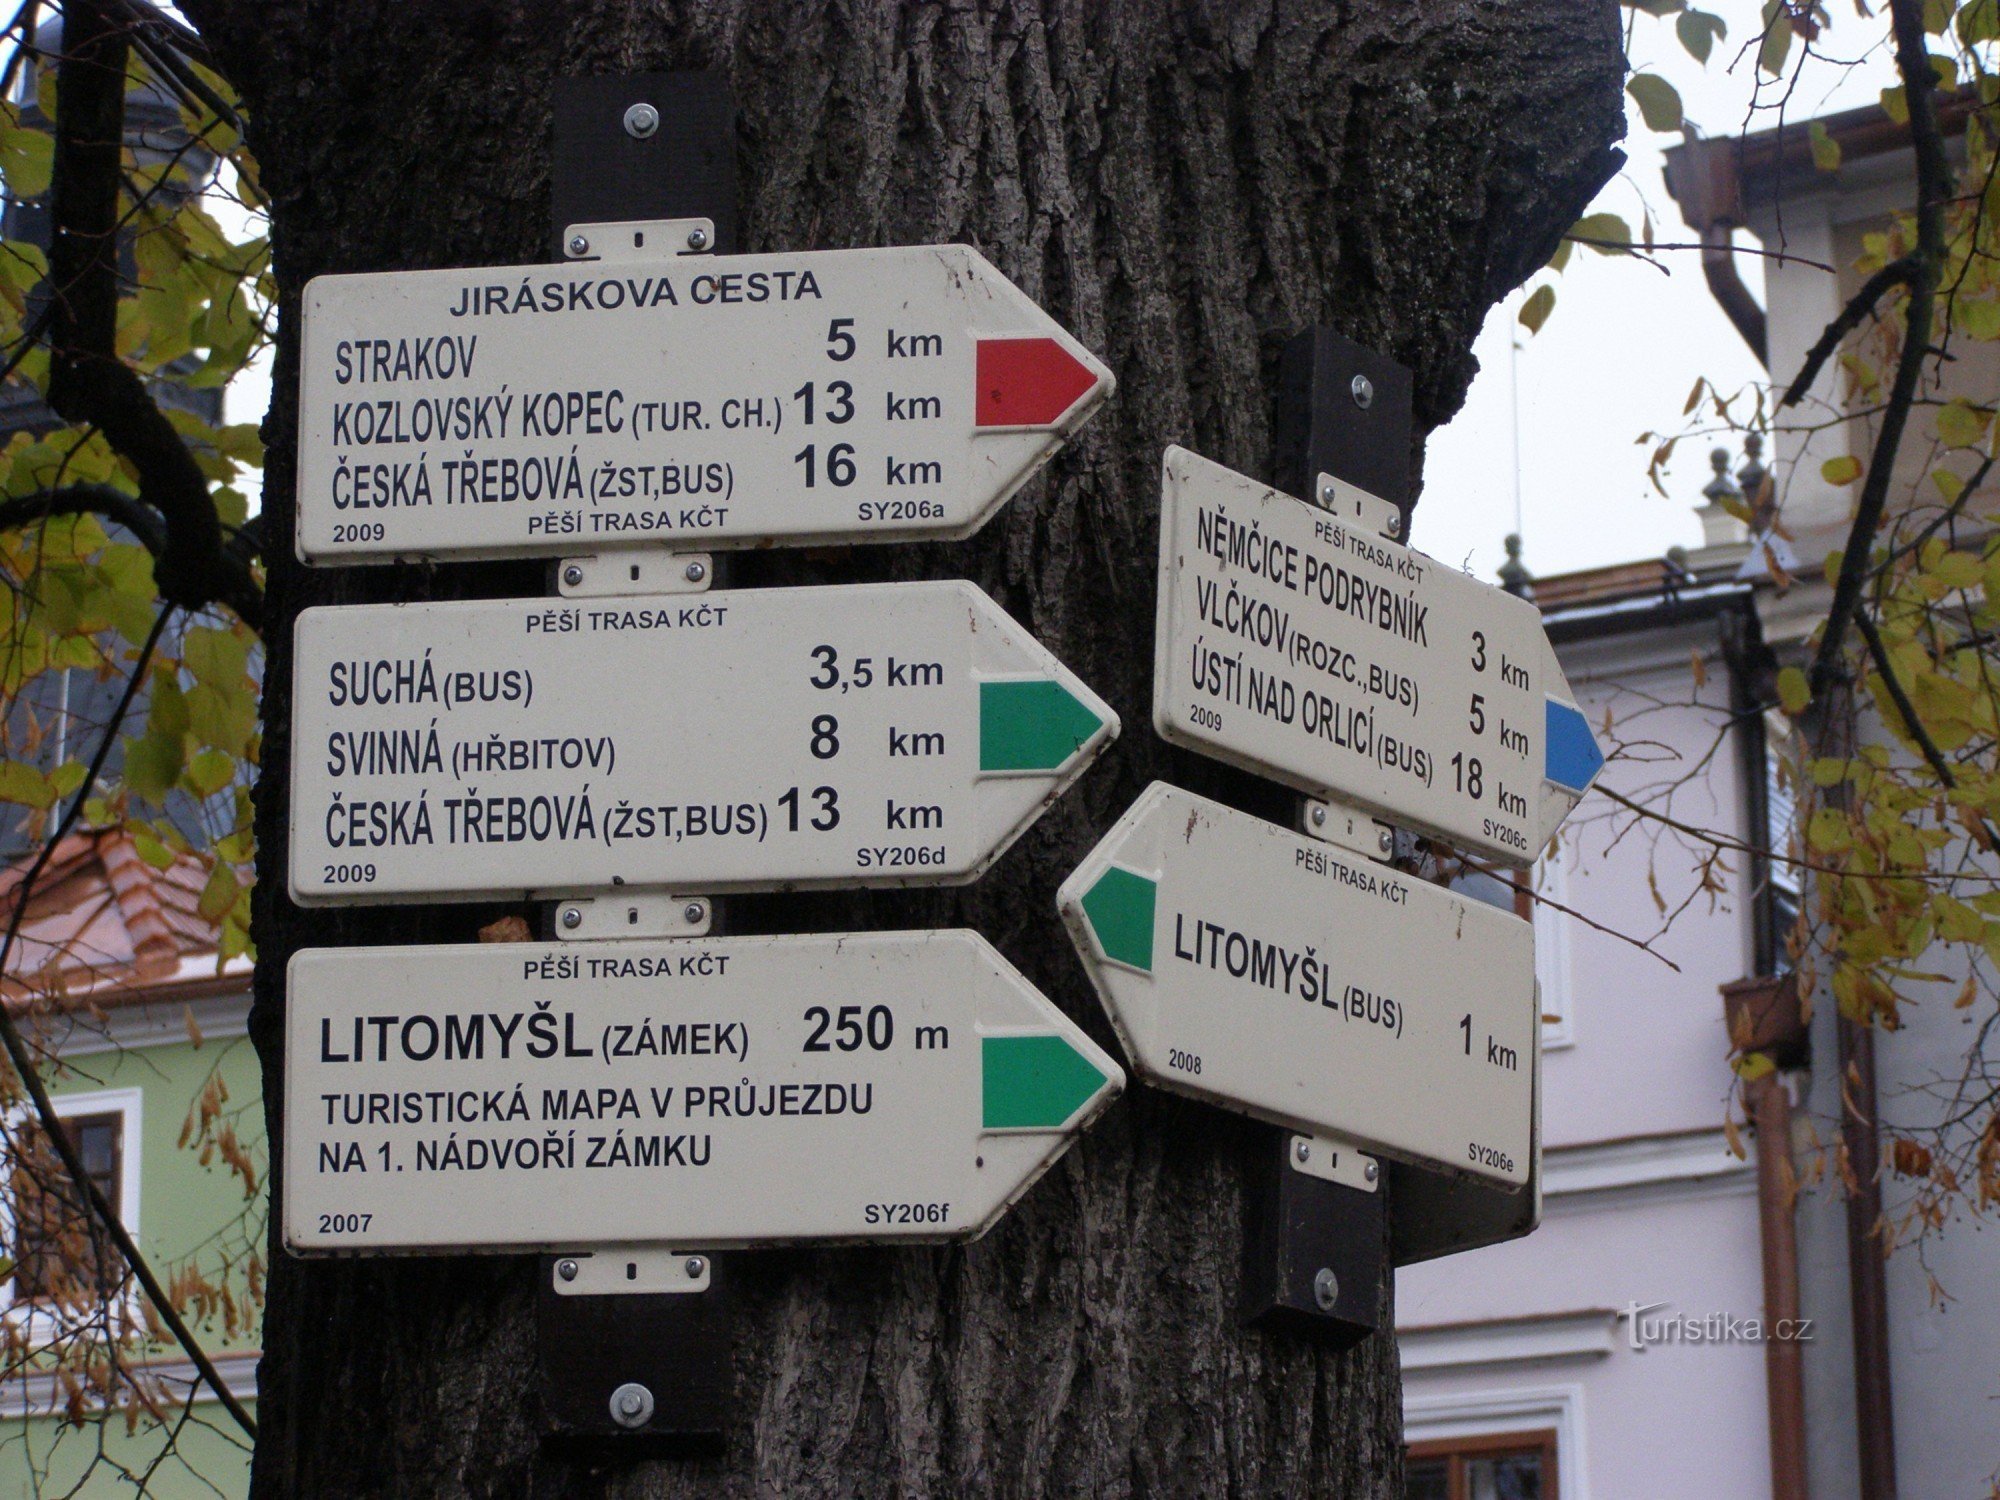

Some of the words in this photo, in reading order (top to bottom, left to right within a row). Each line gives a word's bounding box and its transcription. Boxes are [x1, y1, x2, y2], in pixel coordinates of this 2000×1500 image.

[449, 277, 679, 317] JIRÁSKOVA
[691, 271, 822, 304] CESTA
[335, 335, 477, 384] STRAKOV
[826, 318, 856, 362] 5
[887, 329, 943, 358] km
[333, 384, 514, 446] KOZLOVSKÝ
[523, 389, 624, 437] KOPEC
[632, 400, 710, 440] (TUR.
[721, 396, 782, 434] CH.)
[794, 380, 855, 425] 13
[886, 392, 941, 420] km
[332, 452, 432, 509] ČESKÁ
[442, 445, 584, 504] TŘEBOVÁ
[794, 442, 857, 488] 16
[886, 456, 942, 485] km
[333, 523, 385, 543] 2009
[528, 510, 583, 535] PĚŠÍ
[590, 511, 673, 532] TRASA
[680, 505, 728, 529] KČT
[858, 501, 944, 521] SY206a
[1315, 521, 1346, 550] PĚŠÍ
[1349, 534, 1394, 569] TRASA
[1397, 559, 1424, 584] KČT
[526, 609, 580, 633] PĚŠÍ
[588, 611, 671, 630] TRASA
[679, 604, 728, 628] KČT
[1198, 505, 1297, 591] NĚMČICE
[1304, 554, 1429, 648] PODRYBNÍK
[1471, 631, 1486, 672] 3
[1501, 654, 1529, 691] km
[329, 648, 438, 706] SUCHÁ
[810, 645, 872, 694] 3,5
[887, 657, 943, 686] km
[1190, 704, 1222, 732] 2009
[1192, 636, 1243, 705] ÚSTÍ
[1248, 666, 1295, 725] NAD
[1302, 689, 1374, 758] ORLICÍ
[1451, 751, 1482, 799] 18
[1499, 782, 1527, 818] km
[1470, 693, 1485, 735] 5
[1500, 719, 1528, 756] km
[327, 718, 443, 777] SVINNÁ
[452, 734, 615, 780] (HŘBITOV)
[810, 714, 840, 759] 8
[889, 727, 945, 756] km
[325, 789, 433, 848] ČESKÁ
[444, 783, 596, 844] TŘEBOVÁ
[778, 786, 840, 832] 13
[887, 800, 943, 830] km
[1483, 818, 1527, 850] SY206c
[323, 864, 376, 883] 2009
[857, 846, 945, 866] SY206d
[1295, 848, 1328, 876] PĚŠÍ
[1331, 860, 1376, 892] TRASA
[1381, 880, 1409, 906] KČT
[523, 953, 579, 979] PĚŠÍ
[587, 957, 672, 977] TRASA
[680, 953, 729, 976] KČT
[1174, 913, 1339, 1010] LITOMYŠL
[1460, 1013, 1472, 1055] 1
[1488, 1035, 1517, 1071] km
[320, 1000, 593, 1063] LITOMYŠL
[602, 1018, 749, 1064] (ZÁMEK)
[803, 1004, 893, 1052] 250
[915, 1024, 949, 1049] m
[1169, 1048, 1202, 1075] 2008
[321, 1083, 530, 1125] TURISTICKÁ
[542, 1087, 640, 1120] MAPA
[651, 1087, 673, 1118] V
[685, 1077, 873, 1118] PRŮJEZDU
[319, 1141, 366, 1173] NA
[378, 1141, 403, 1172] 1.
[416, 1130, 576, 1171] NÁDVOŘÍ
[585, 1129, 711, 1167] ZÁMKU
[1468, 1142, 1514, 1173] SY206e
[319, 1214, 373, 1233] 2007
[865, 1203, 949, 1224] SY206f
